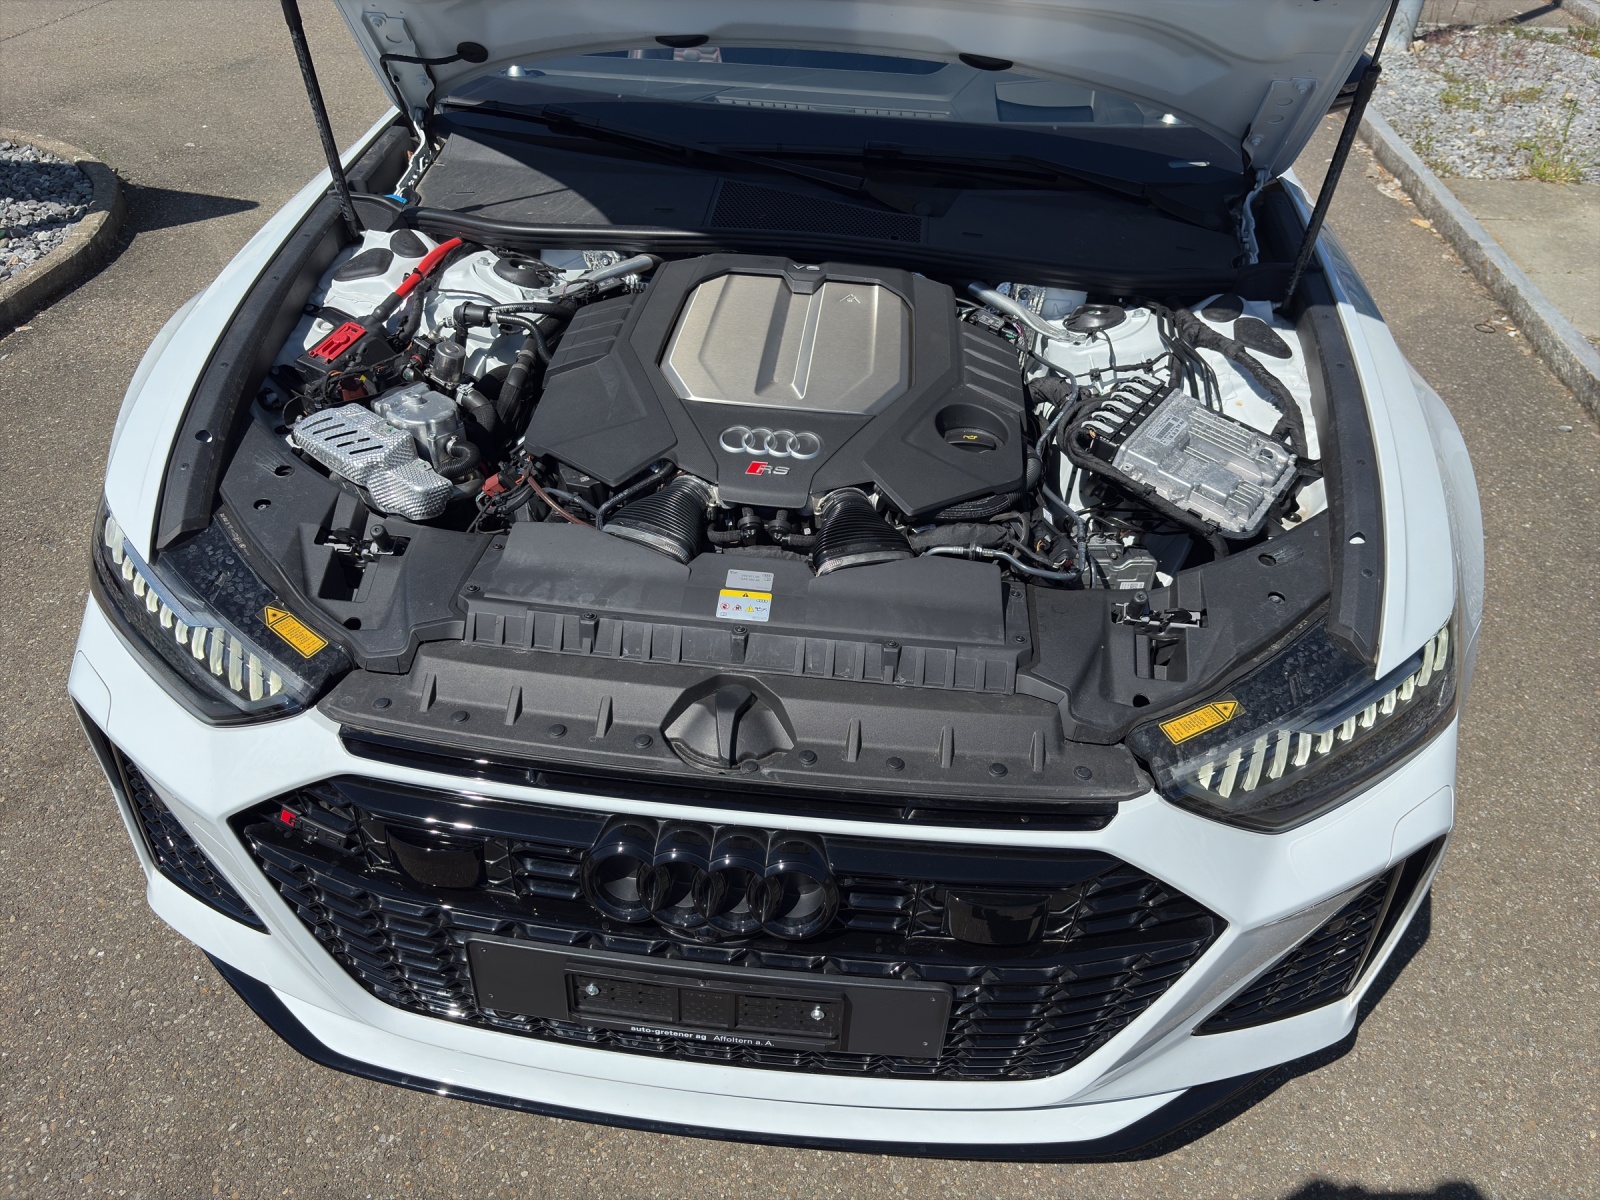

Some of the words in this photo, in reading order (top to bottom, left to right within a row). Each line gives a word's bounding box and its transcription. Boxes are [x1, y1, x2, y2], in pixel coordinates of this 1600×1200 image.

[750, 463, 790, 475] RS
[630, 1026, 693, 1038] auto-gretener
[713, 1035, 753, 1044] Affoltern
